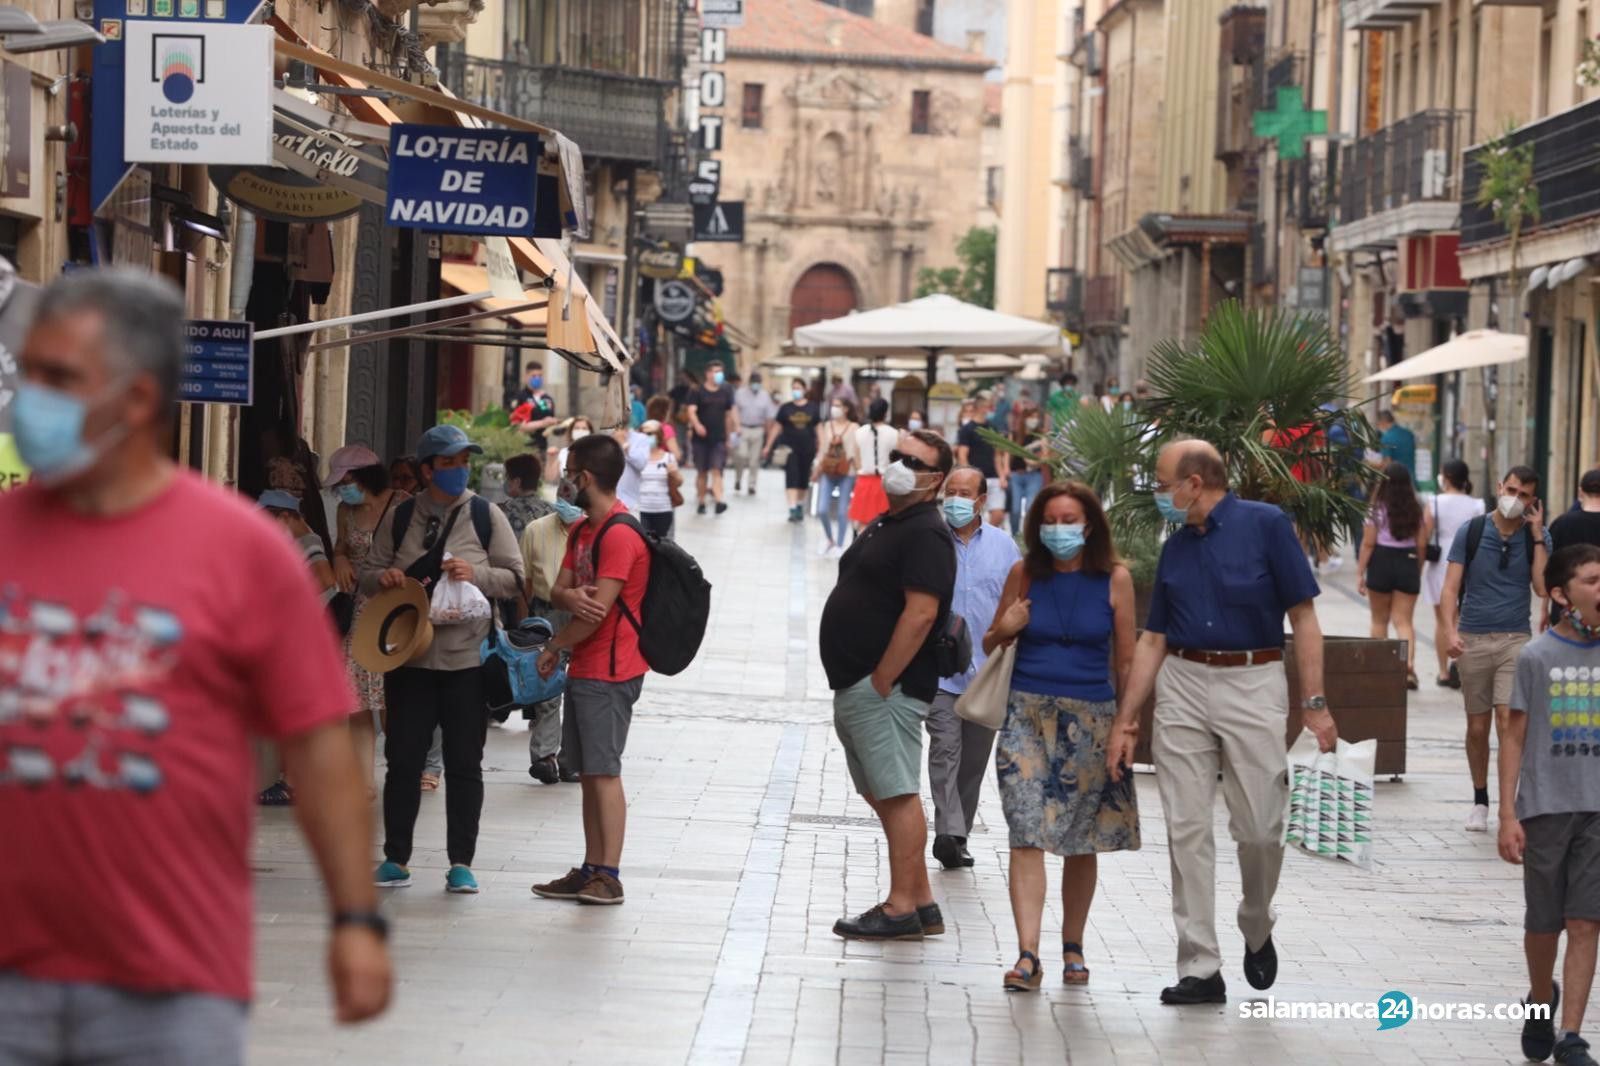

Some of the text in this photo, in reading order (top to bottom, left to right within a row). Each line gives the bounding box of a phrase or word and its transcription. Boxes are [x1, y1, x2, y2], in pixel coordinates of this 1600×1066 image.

[151, 105, 220, 122] Loterías y
[151, 122, 241, 136] Apuestas del
[150, 138, 199, 150] Estado
[396, 134, 529, 164] LOTERÍA
[440, 169, 485, 193] DE
[390, 198, 529, 228] NAVIDAD
